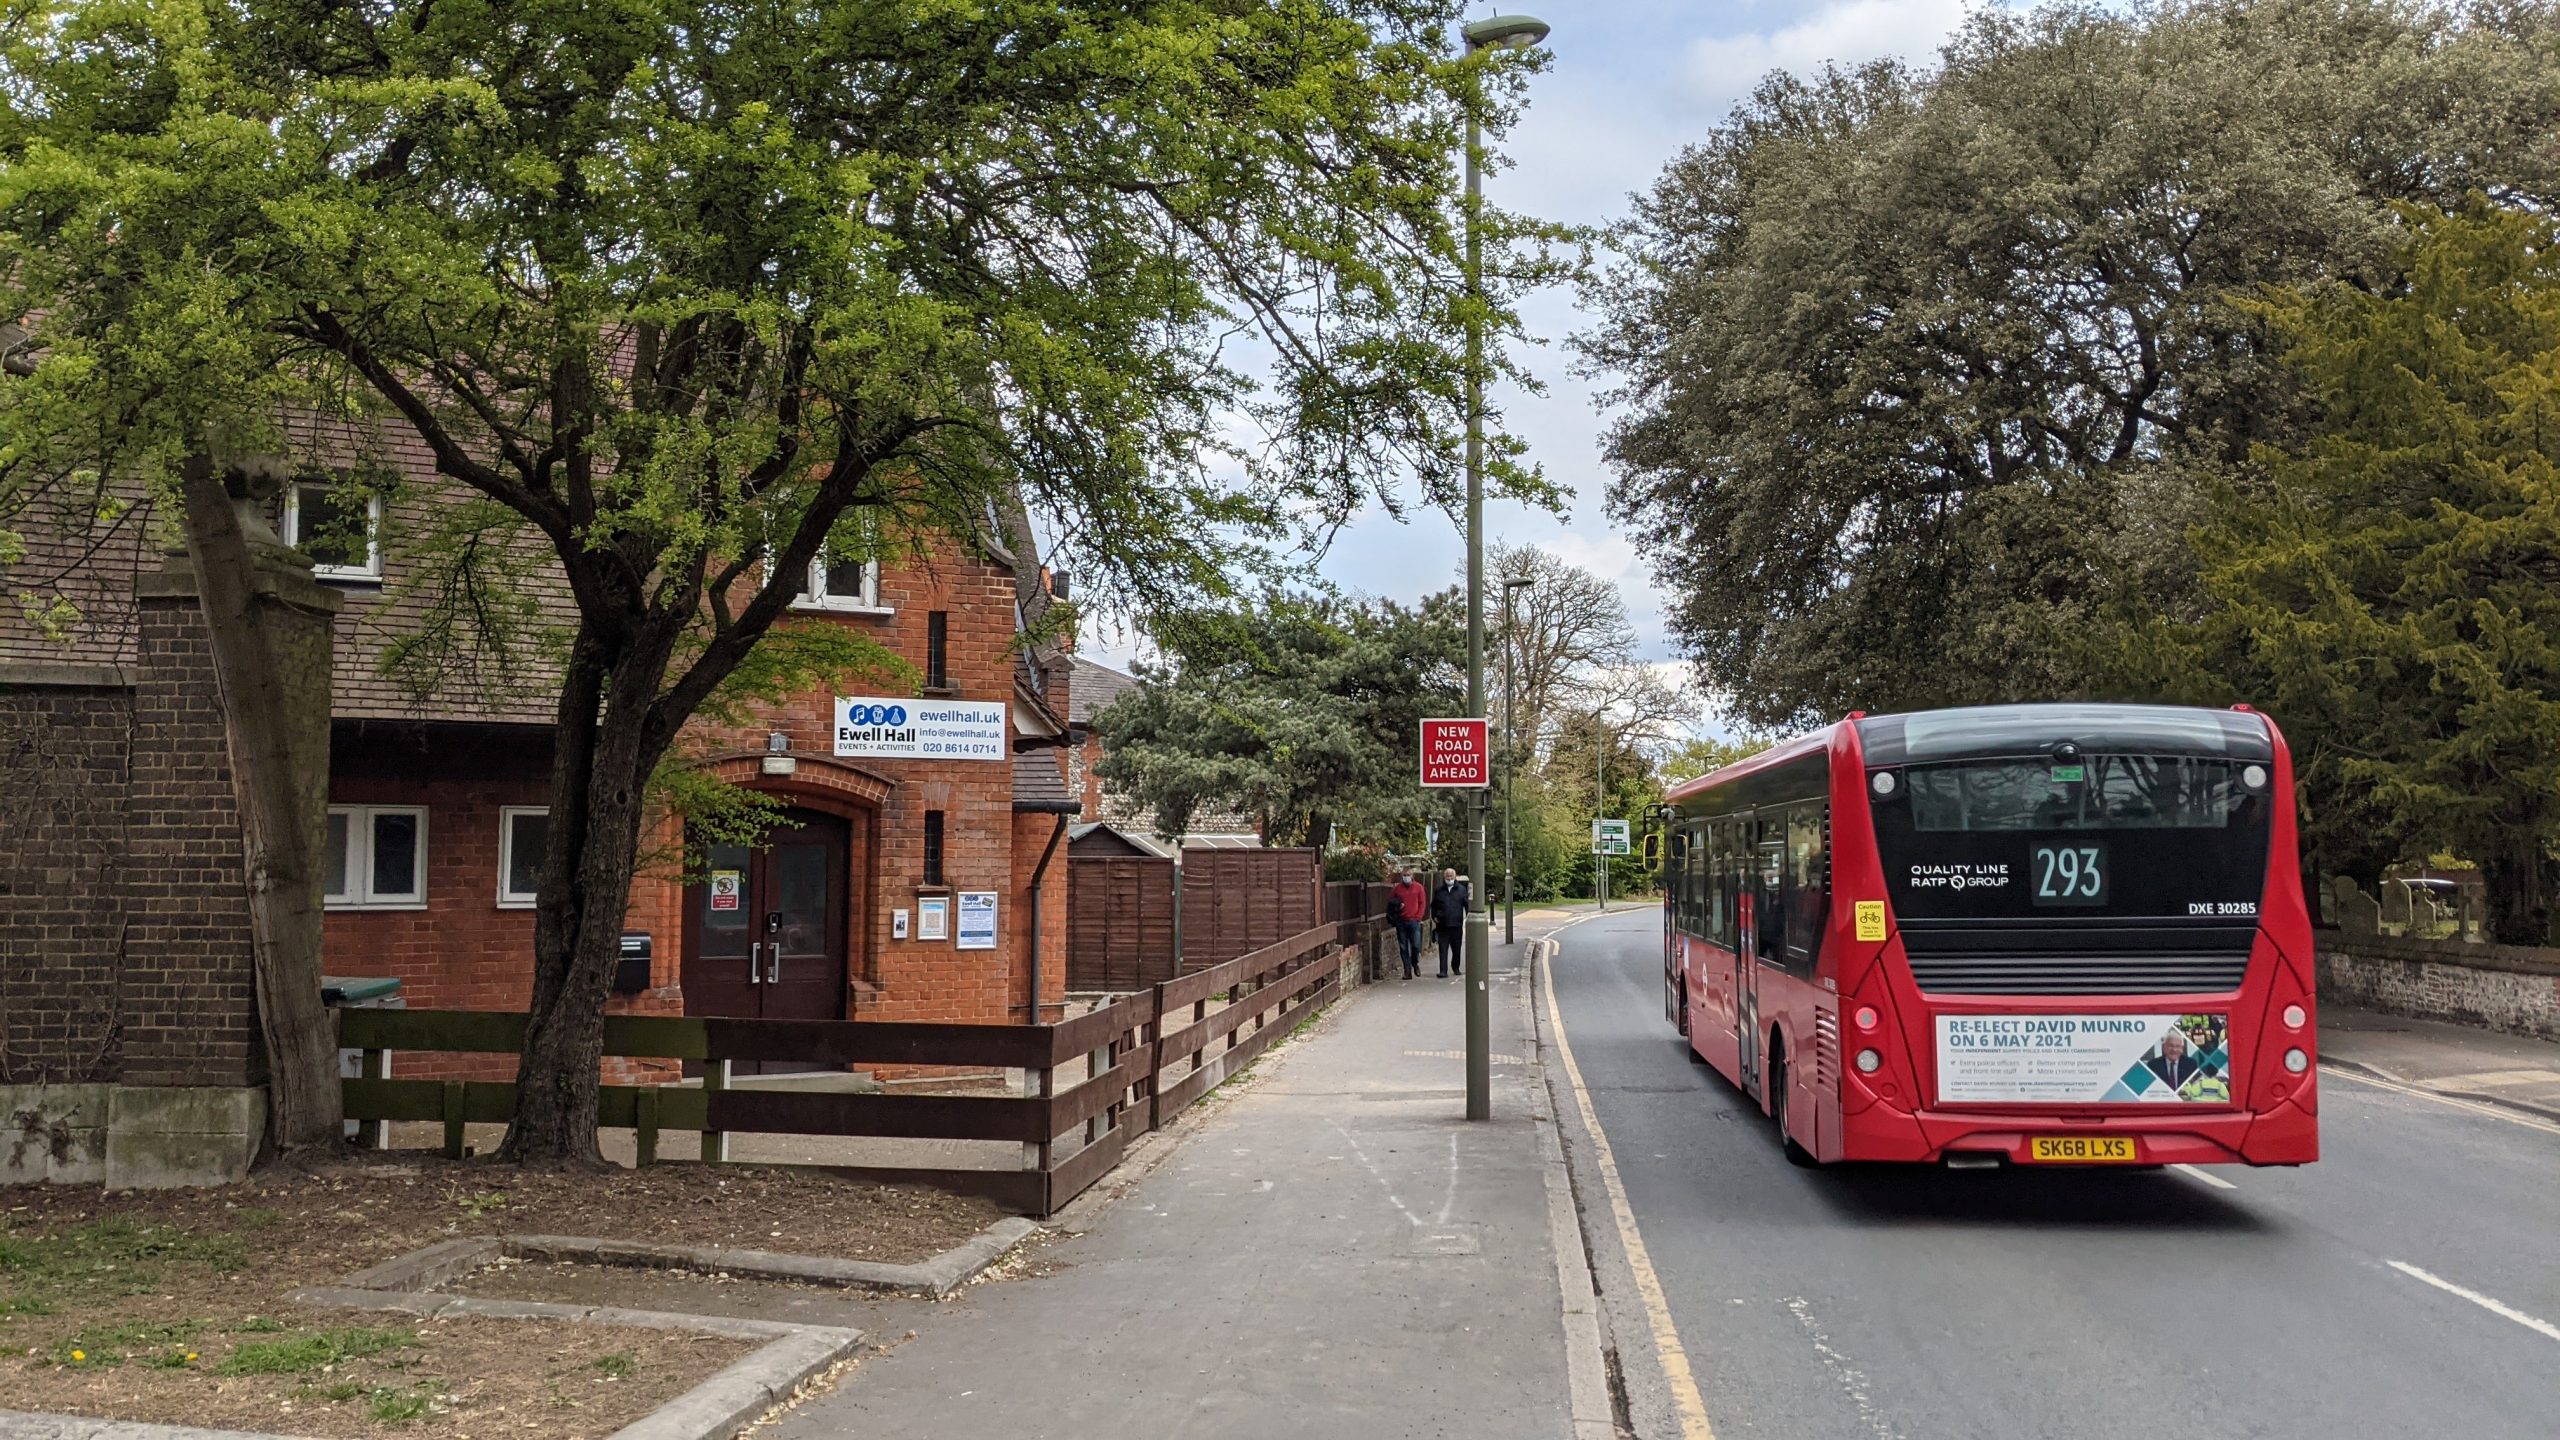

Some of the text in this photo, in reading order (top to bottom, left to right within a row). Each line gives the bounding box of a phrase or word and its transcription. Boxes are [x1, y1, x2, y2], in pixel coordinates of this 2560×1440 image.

[919, 710, 1001, 724] ewellhall.uk
[839, 727, 916, 742] Ewell Hall
[919, 728, 1001, 739] info@ewellhall.uk
[1437, 726, 1470, 738] NEW
[838, 743, 867, 751] EVENTS
[876, 743, 916, 752] ACTIVITIES
[923, 743, 997, 754] 020 8614 0714
[1435, 740, 1473, 751] ROAD
[1428, 753, 1480, 765] LAYOUT
[1429, 767, 1478, 779] AHEAD
[1911, 865, 2009, 875] QUALITY LINE
[2037, 848, 2101, 897] 293
[1911, 877, 2009, 887] RATP GROUP
[2188, 902, 2256, 915] DXE 30285
[1950, 1020, 2146, 1033] RE-ELECT DAVID MUNRO
[1950, 1034, 2072, 1047] ON 6 MAY 2021
[2040, 1140, 2126, 1156] SK68 LXS
